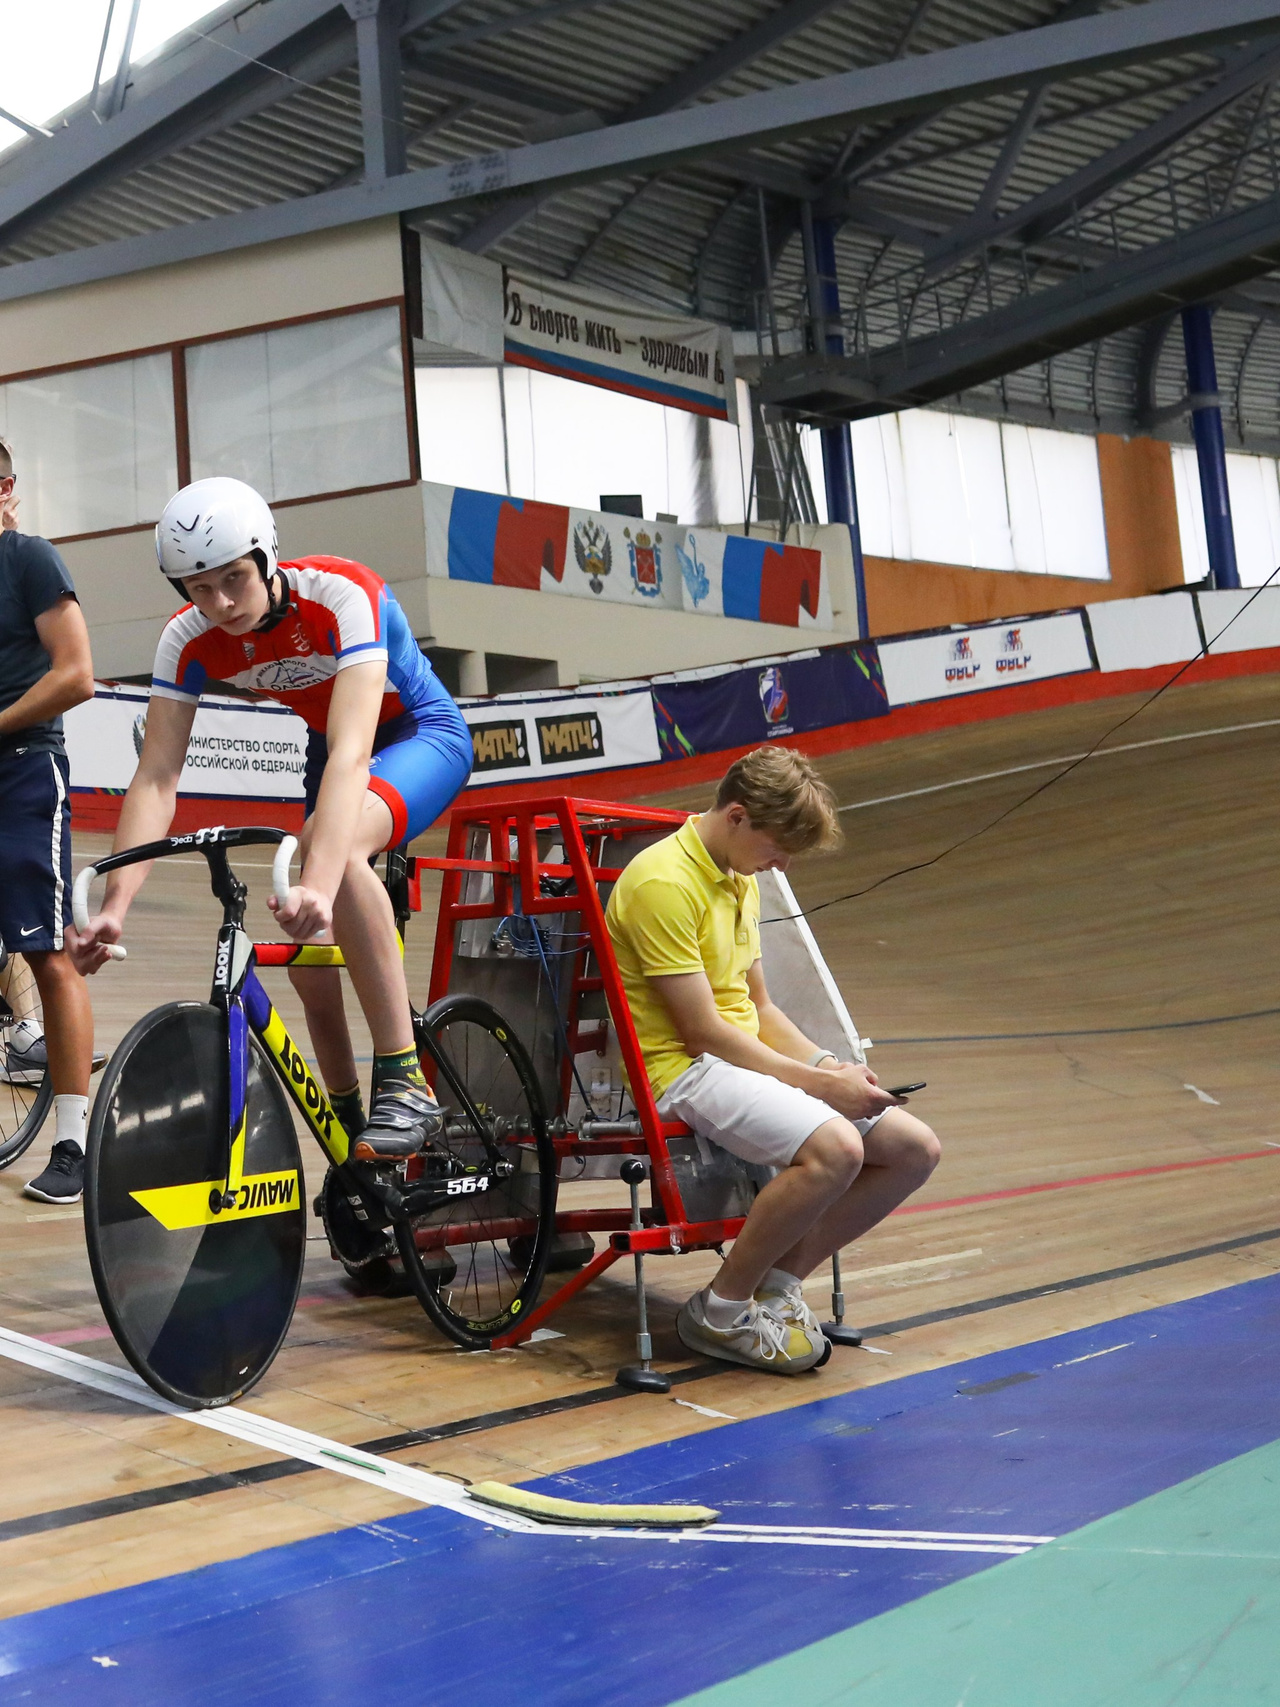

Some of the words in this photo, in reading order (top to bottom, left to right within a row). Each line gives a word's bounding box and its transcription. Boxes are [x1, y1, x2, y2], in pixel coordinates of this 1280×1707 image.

[585, 320, 622, 354] жить
[640, 336, 709, 379] здоровым
[188, 736, 261, 752] ИНИСТЕРСТВО
[263, 741, 301, 755] СПОРТА
[540, 719, 600, 756] МАТЧ!
[186, 754, 250, 771] ОССИЙСКОЙ
[252, 759, 307, 775] ФЕДЕРАЦИ
[215, 939, 231, 987] LOOK
[279, 1033, 336, 1141] LOOK
[238, 1178, 295, 1210] MAVIC
[446, 1176, 490, 1196] 564
